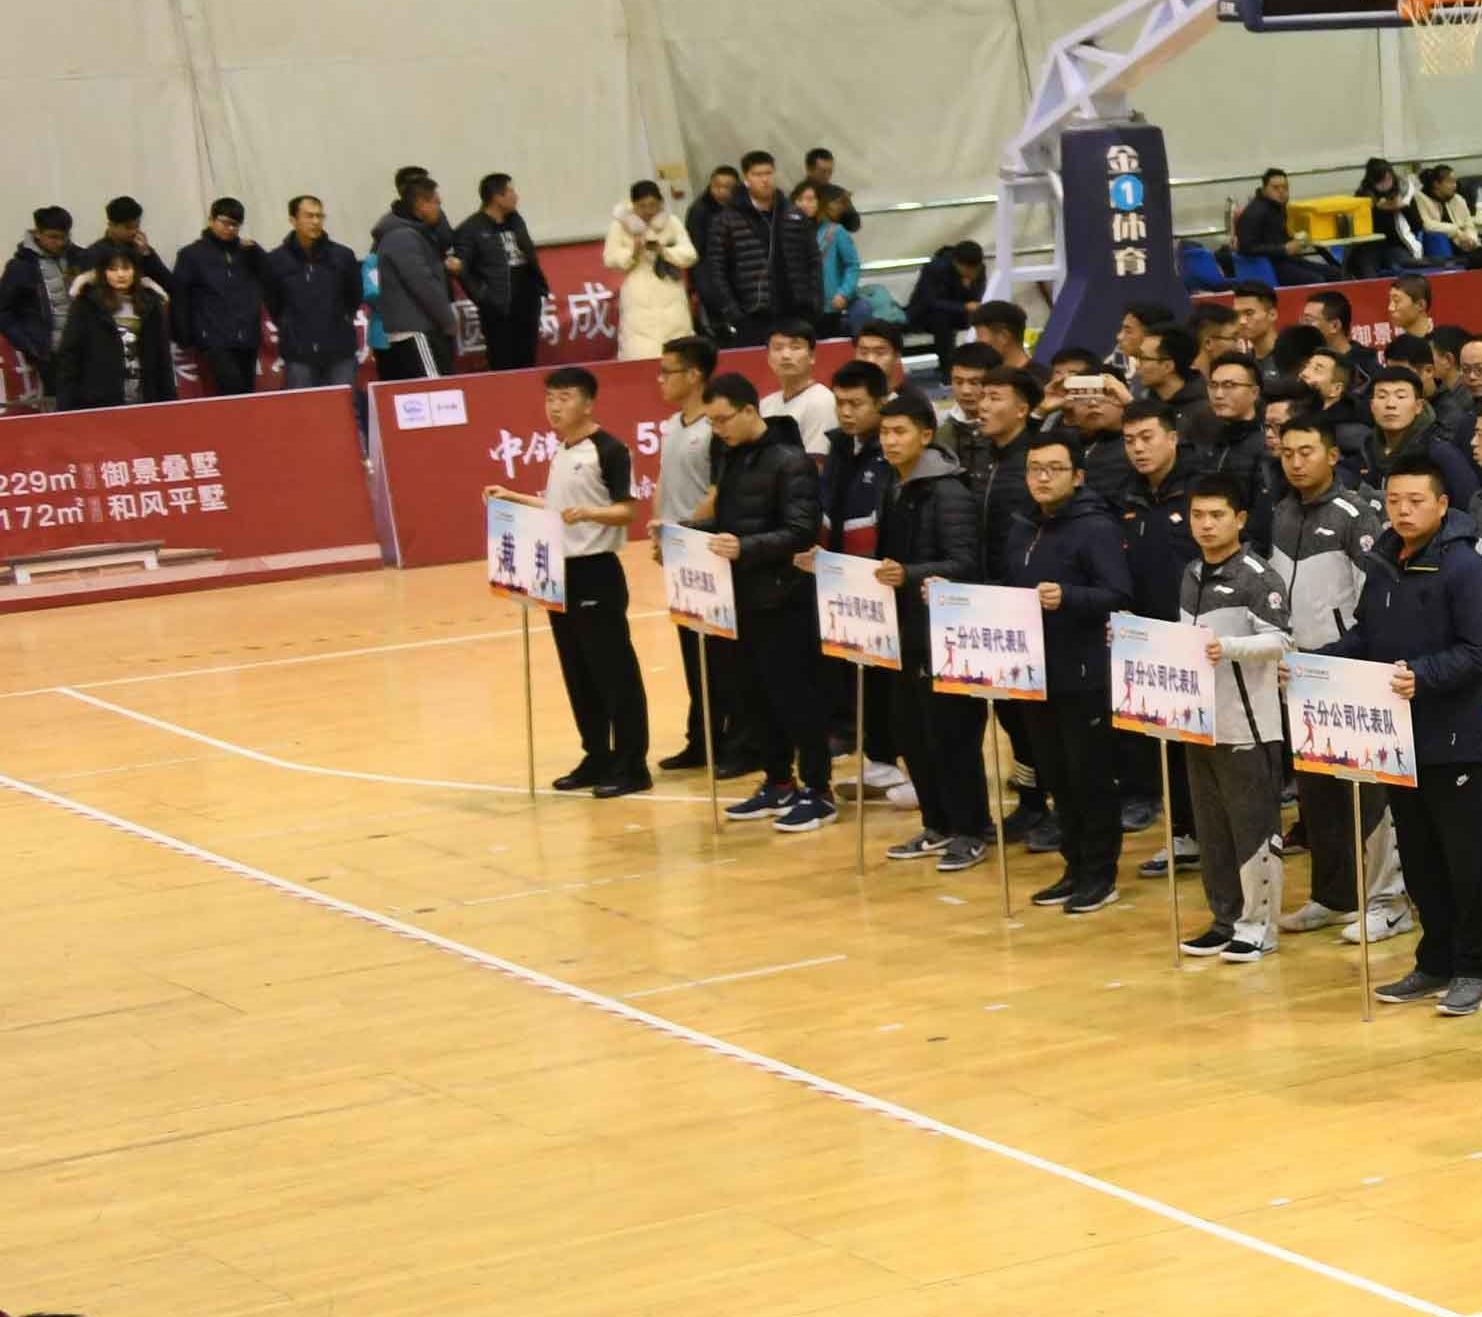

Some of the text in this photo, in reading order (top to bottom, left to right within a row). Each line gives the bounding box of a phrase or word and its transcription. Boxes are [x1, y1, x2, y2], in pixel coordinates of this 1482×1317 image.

[1121, 182, 1134, 205] 1
[100, 451, 222, 489] 御景叠墅
[489, 428, 560, 479] 中铁
[107, 484, 229, 522] 和风平墅
[497, 531, 550, 581] 裁判
[1124, 659, 1200, 696] 四分公司代表队
[1302, 699, 1397, 738] 六分公司代表队
